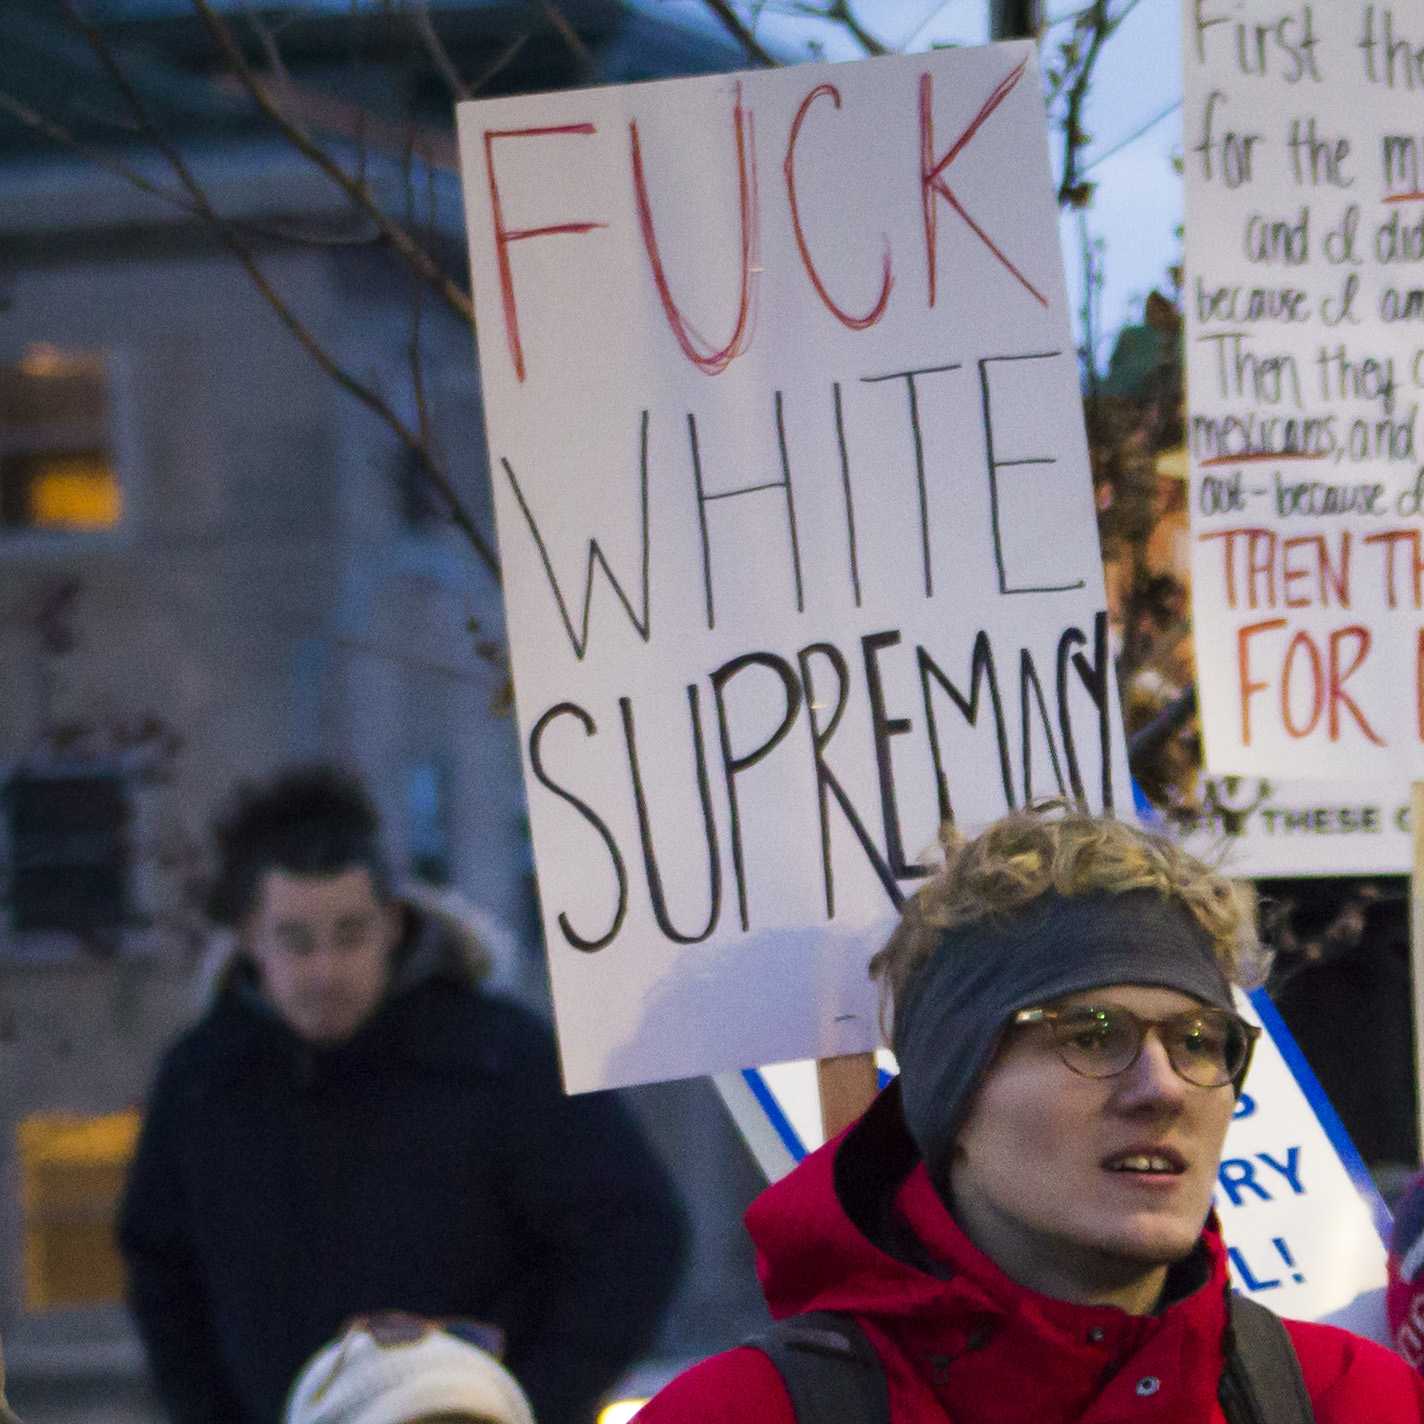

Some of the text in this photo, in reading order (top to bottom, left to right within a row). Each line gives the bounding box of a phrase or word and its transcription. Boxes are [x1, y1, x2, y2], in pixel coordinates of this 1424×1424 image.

[1194, 89, 1265, 188] for
[1287, 117, 1354, 188] the
[483, 56, 1050, 383] FUCK
[1245, 207, 1310, 266] and
[1322, 205, 1363, 266] I
[1195, 275, 1311, 325] because
[1318, 273, 1361, 327] I
[1197, 332, 1303, 408] Then
[1316, 343, 1403, 415] they
[1348, 403, 1418, 464] and
[500, 351, 1084, 661] WHITE
[1198, 528, 1352, 609] THEN
[1238, 618, 1387, 747] FOR
[1261, 808, 1381, 834] THESE
